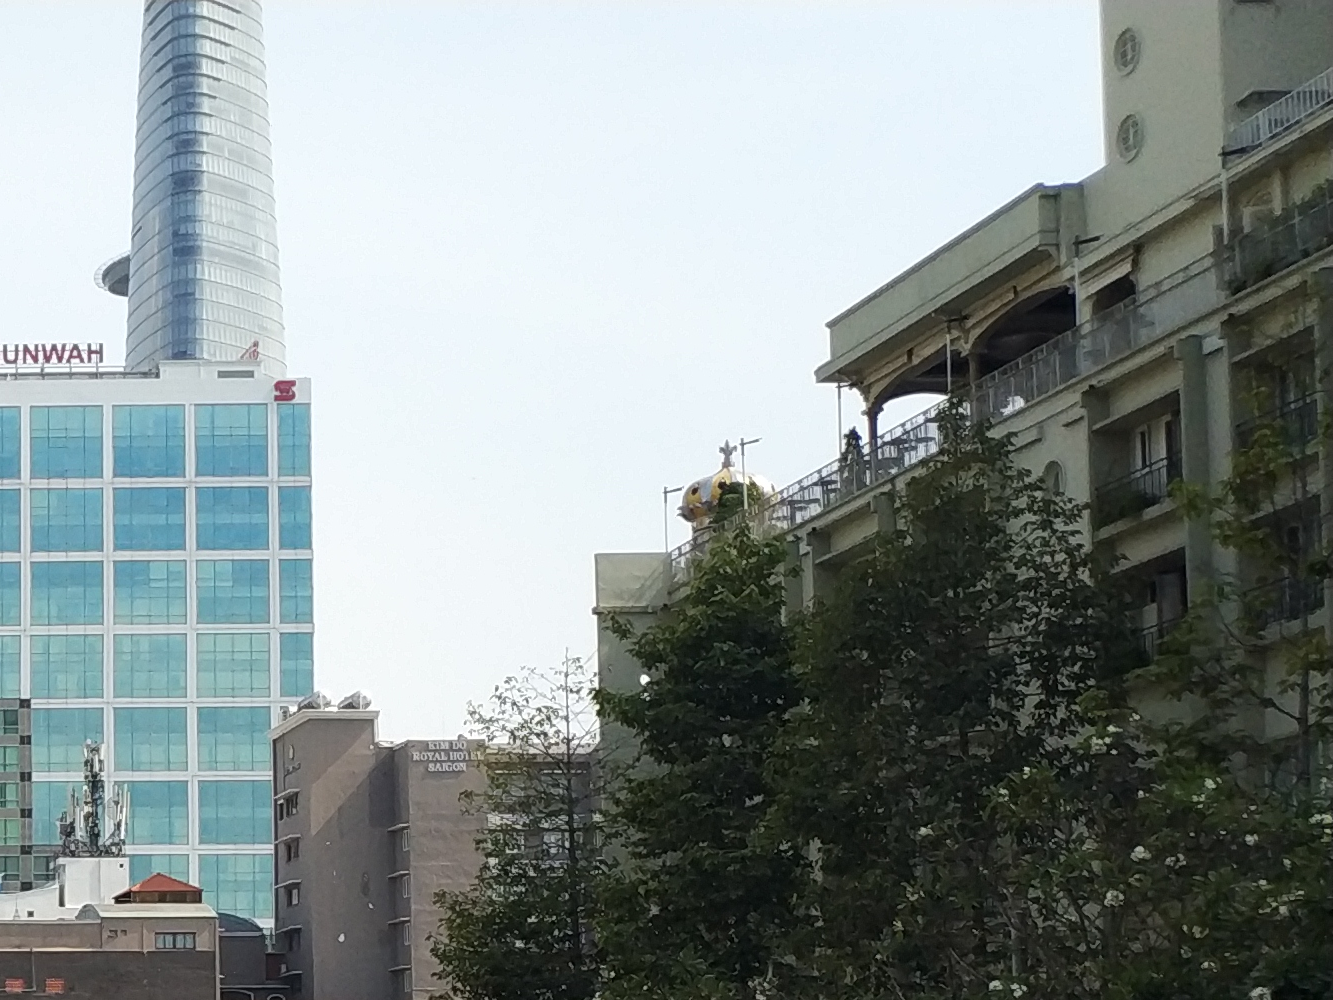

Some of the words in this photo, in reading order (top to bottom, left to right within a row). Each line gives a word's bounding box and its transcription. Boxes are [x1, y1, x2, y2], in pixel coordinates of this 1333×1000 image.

[428, 741, 449, 750] KIM
[413, 752, 447, 761] ROYAL
[428, 763, 467, 772] SAIGON
